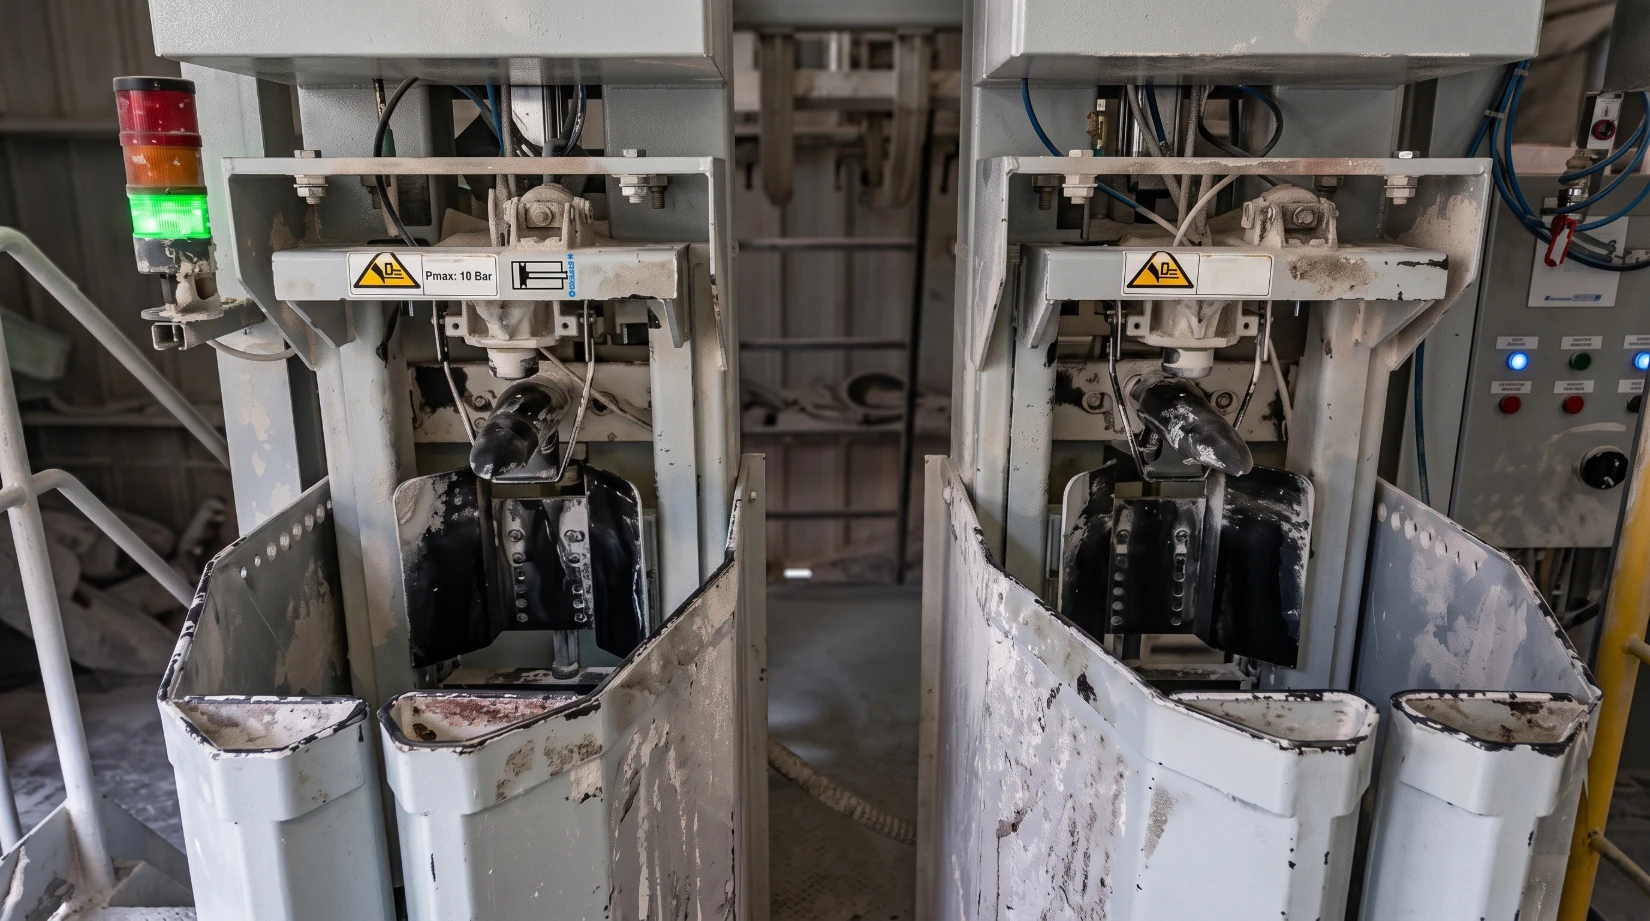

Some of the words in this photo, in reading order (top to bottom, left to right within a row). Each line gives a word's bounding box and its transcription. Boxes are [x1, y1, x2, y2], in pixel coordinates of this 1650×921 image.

[425, 270, 457, 281] Pmax:
[460, 271, 472, 281] 10
[474, 271, 493, 281] Bar
